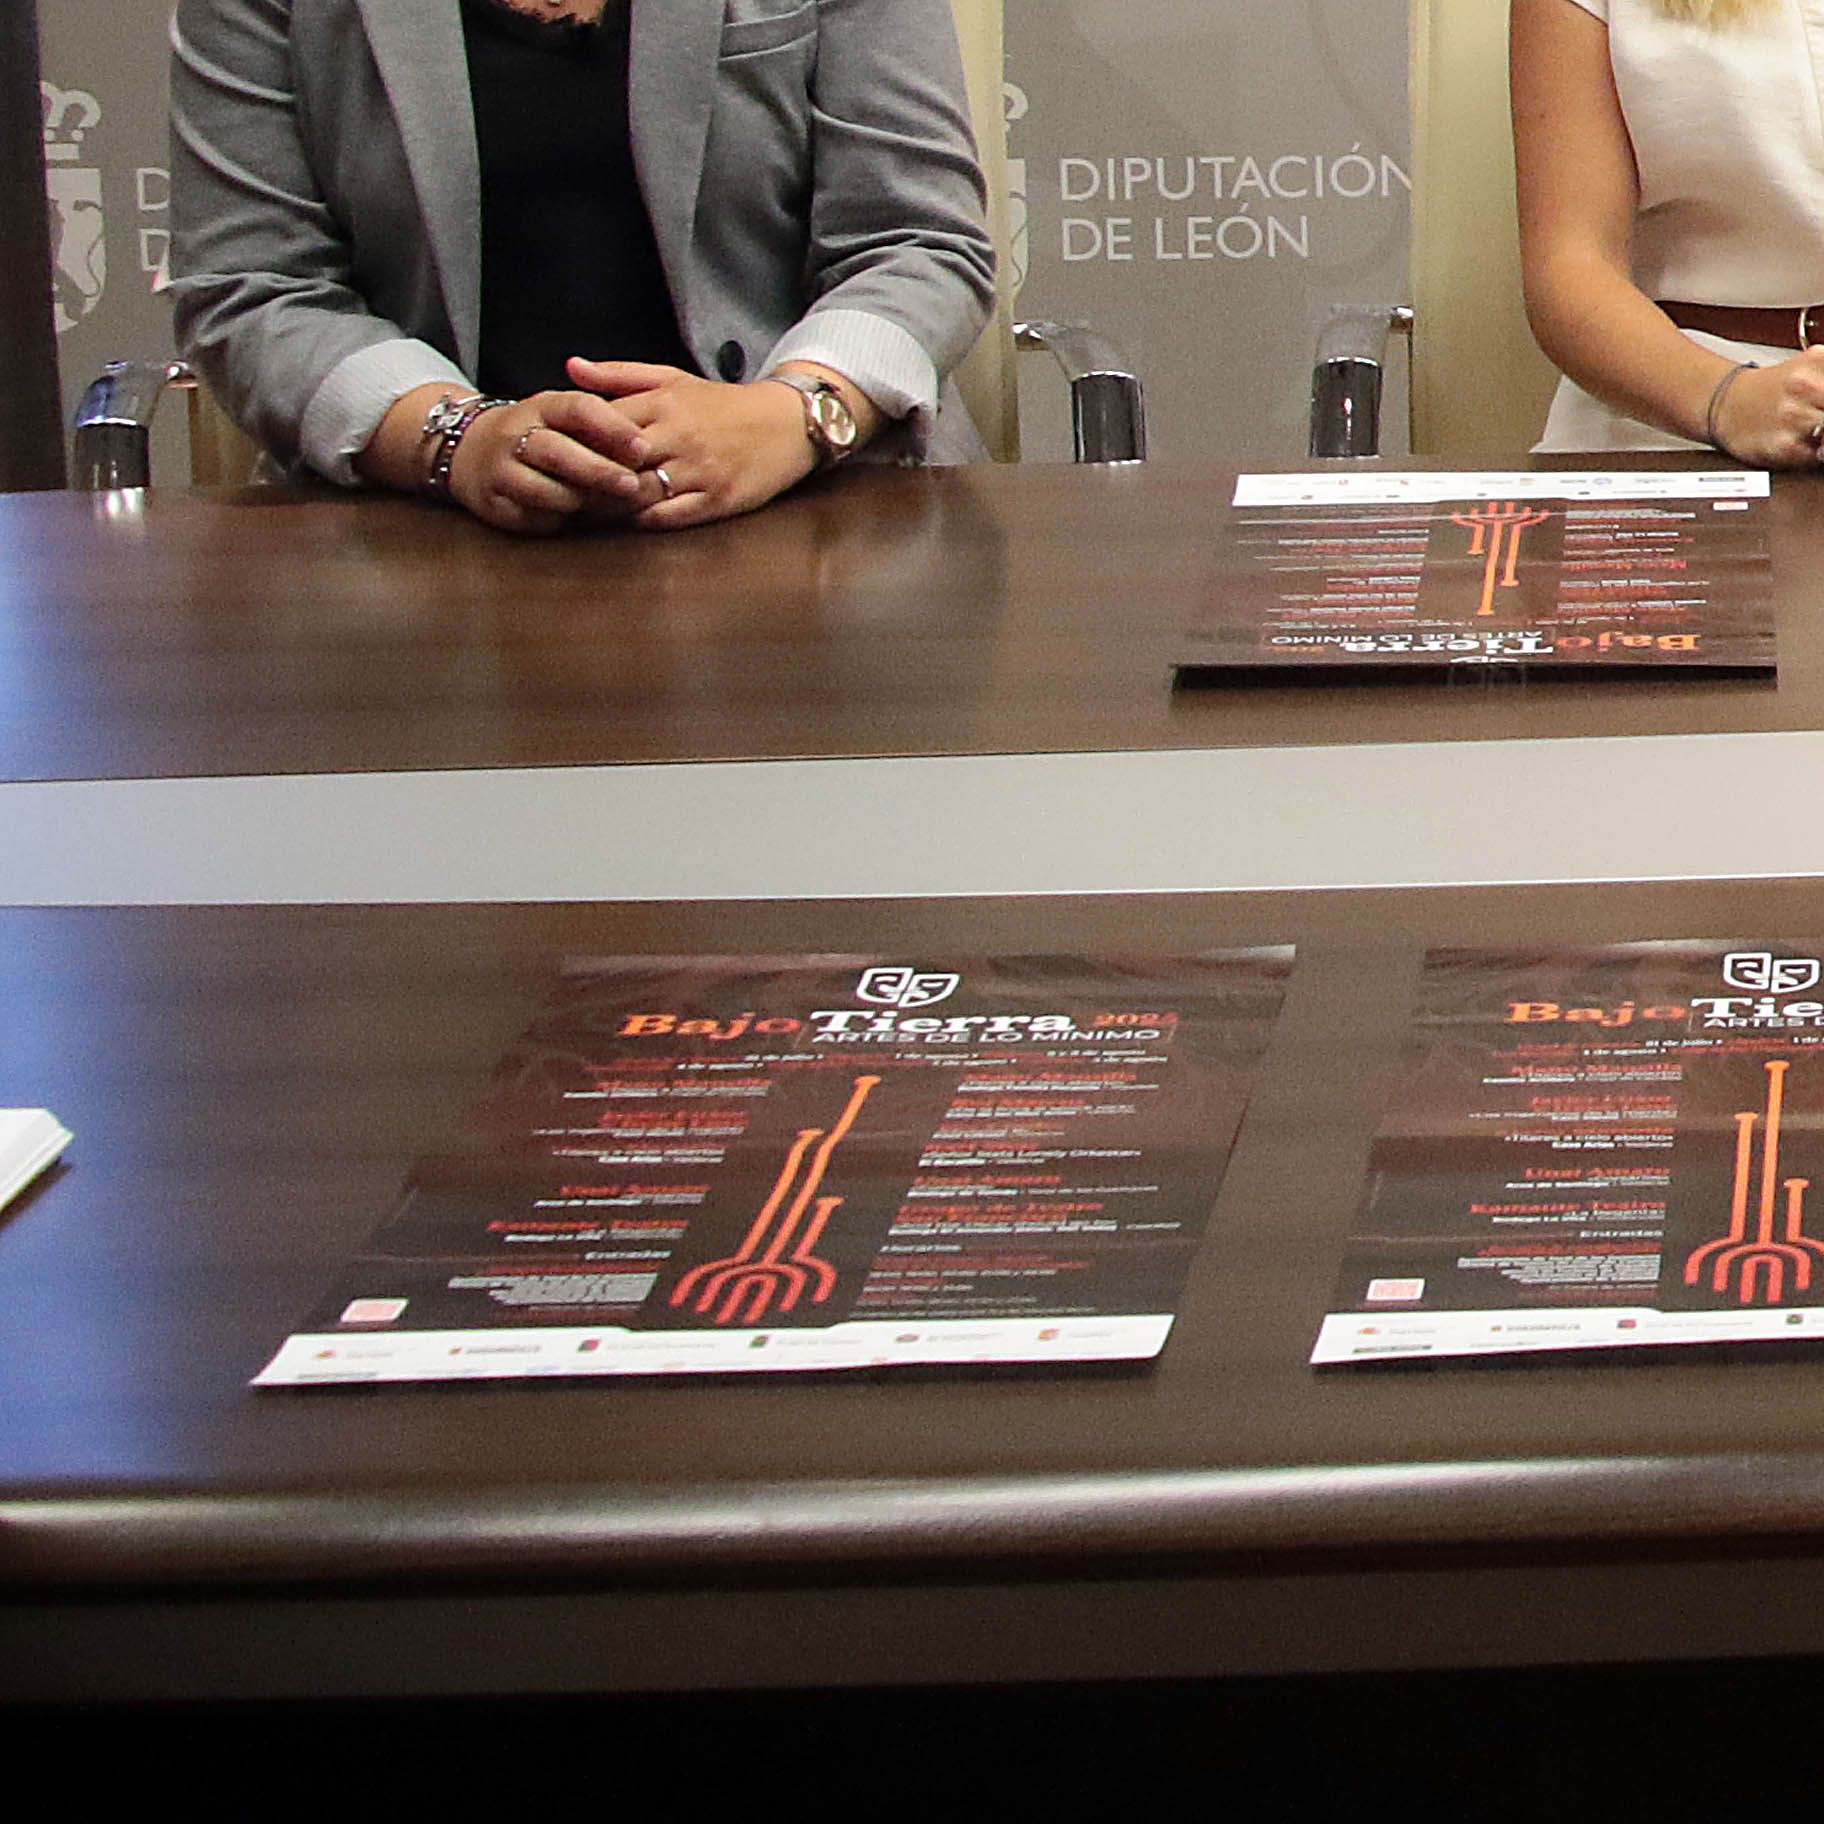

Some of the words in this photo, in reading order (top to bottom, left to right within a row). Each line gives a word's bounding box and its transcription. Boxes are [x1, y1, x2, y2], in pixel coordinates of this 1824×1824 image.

[1062, 218, 1132, 260] DE
[1156, 203, 1308, 259] LEÓN
[1556, 631, 1701, 653] Bajo
[616, 1011, 802, 1041] Bajo
[810, 1010, 1077, 1034] Tierra
[1503, 1000, 1686, 1027] Bajo
[1703, 1017, 1805, 1028] ARTES
[812, 1032, 916, 1044] ARTES
[924, 1031, 971, 1044] DE
[979, 1030, 1025, 1043] LO
